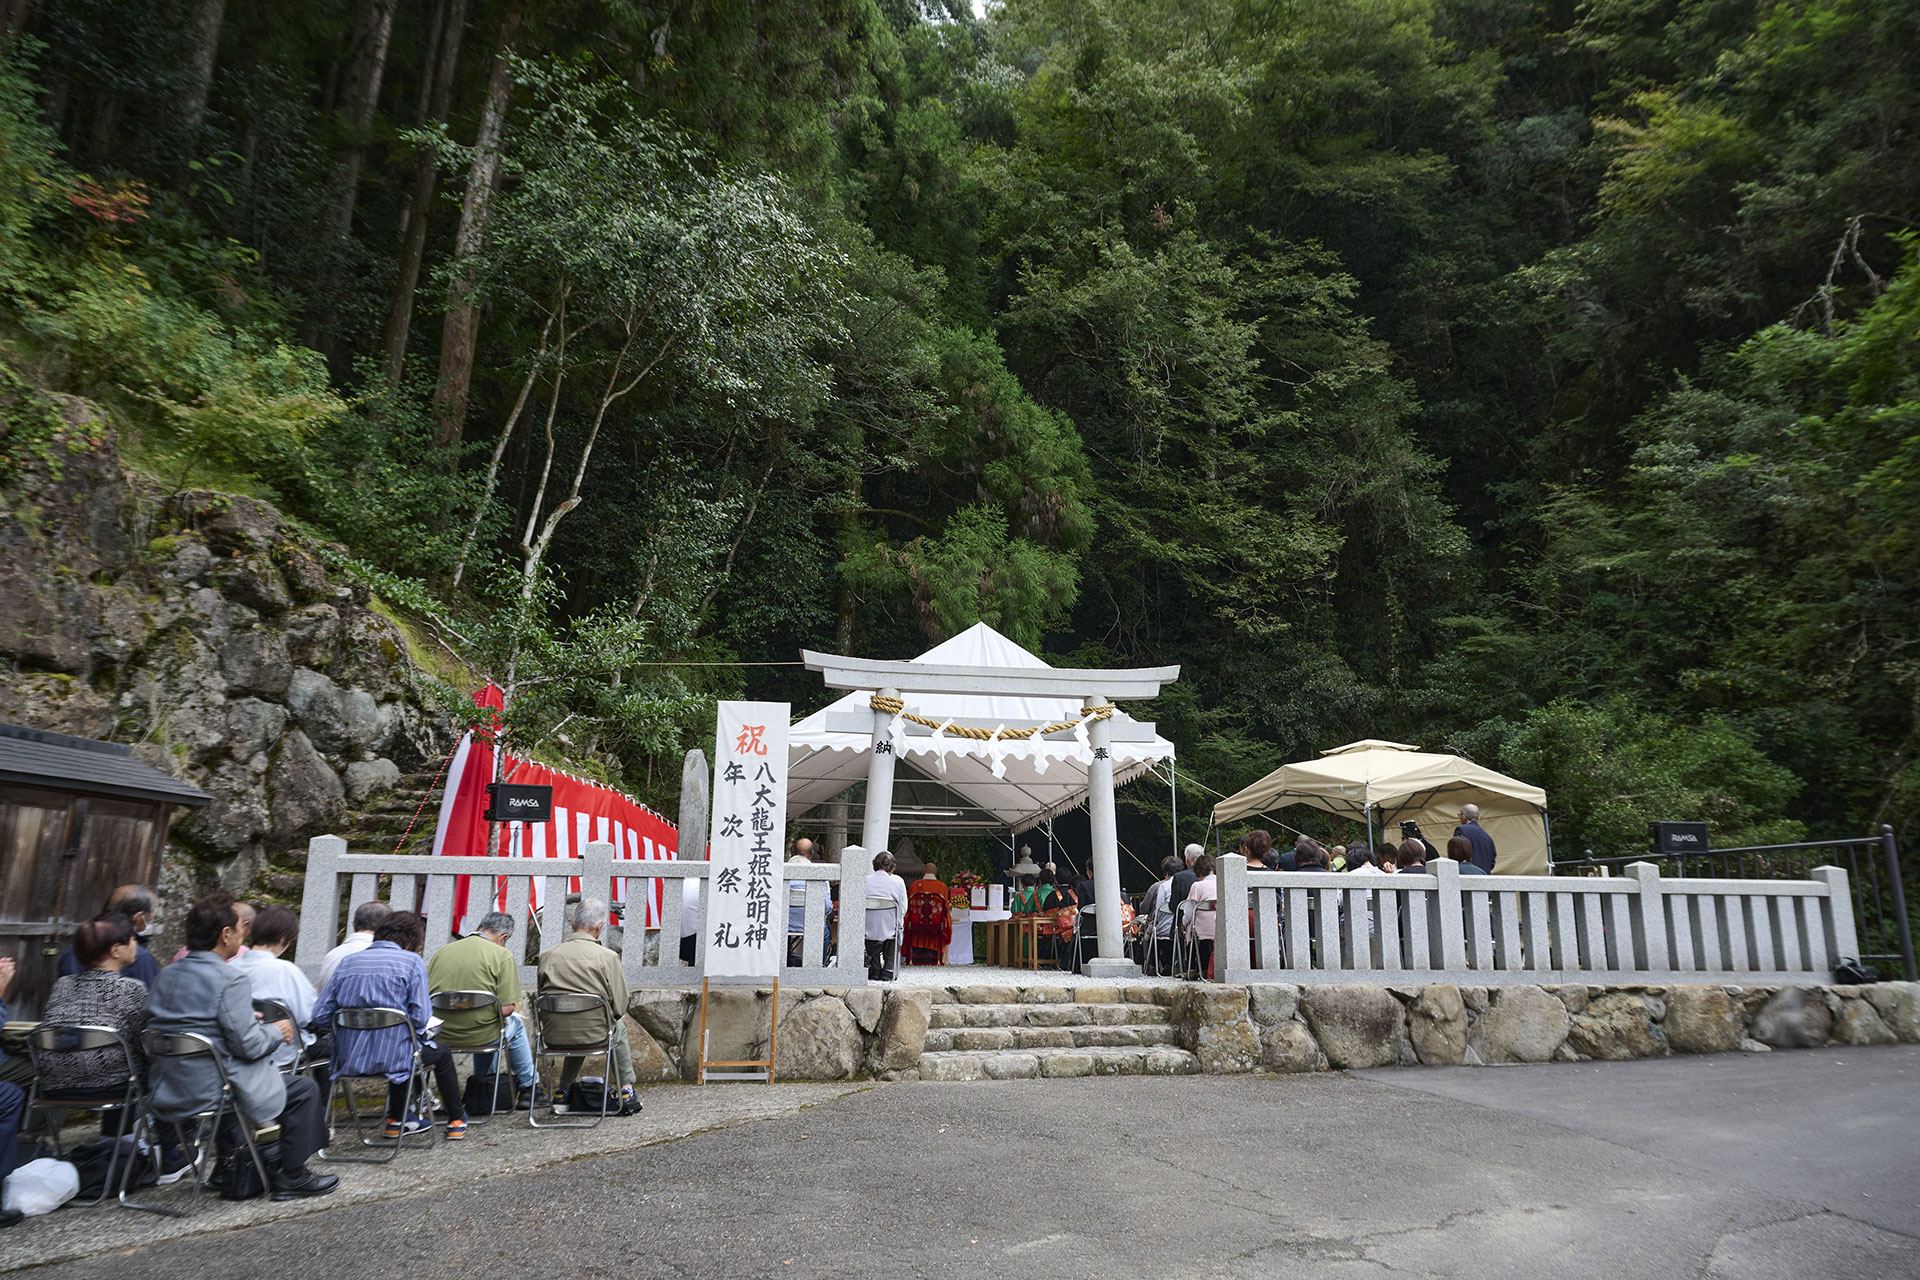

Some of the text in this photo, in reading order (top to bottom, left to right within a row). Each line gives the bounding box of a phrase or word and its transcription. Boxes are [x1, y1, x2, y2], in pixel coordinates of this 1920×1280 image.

[734, 724, 768, 756] 祝
[875, 740, 892, 755] 納
[1094, 747, 1109, 761] 奉
[509, 798, 540, 807] RAMSA
[1671, 833, 1698, 842] RAMSA
[713, 760, 746, 949] 年次祭礼
[743, 762, 777, 950] 八大龍王姫松明神
